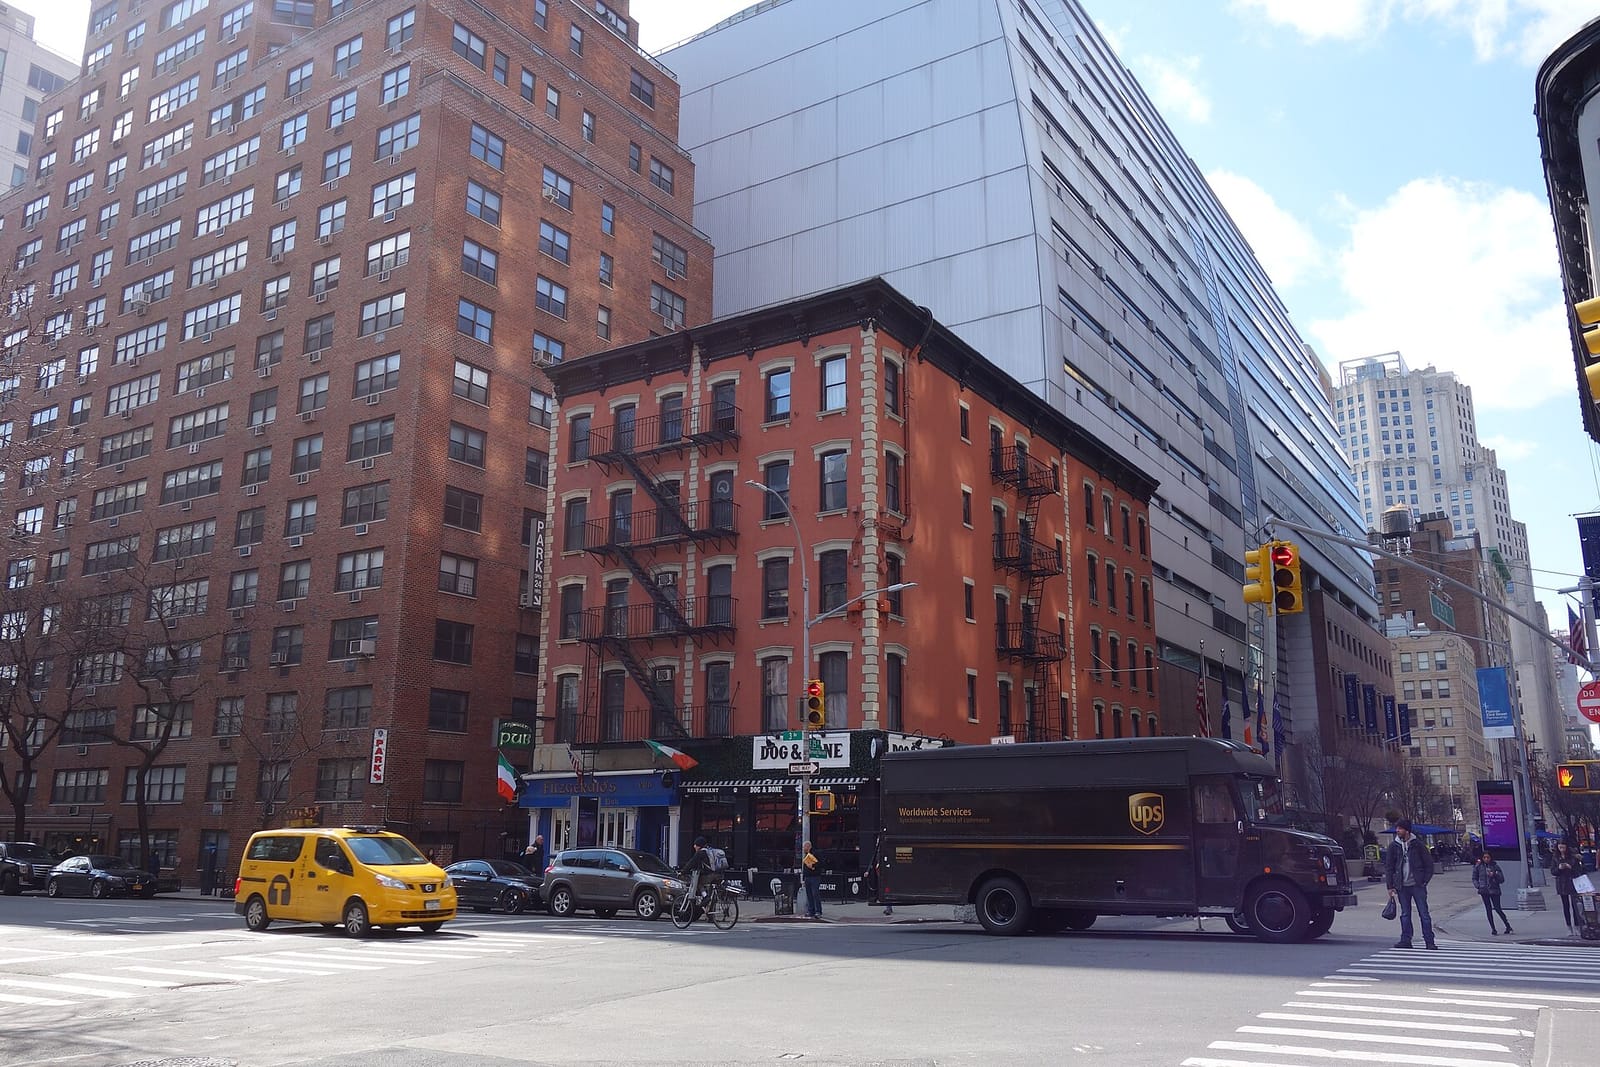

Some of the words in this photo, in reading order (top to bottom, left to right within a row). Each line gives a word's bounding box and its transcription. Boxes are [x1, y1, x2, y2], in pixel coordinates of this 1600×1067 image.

[535, 520, 545, 573] PARK
[374, 739, 384, 772] PARK
[760, 745, 788, 760] DOG
[791, 744, 802, 760] &
[899, 807, 938, 816] Worldwide
[940, 807, 972, 816] Services
